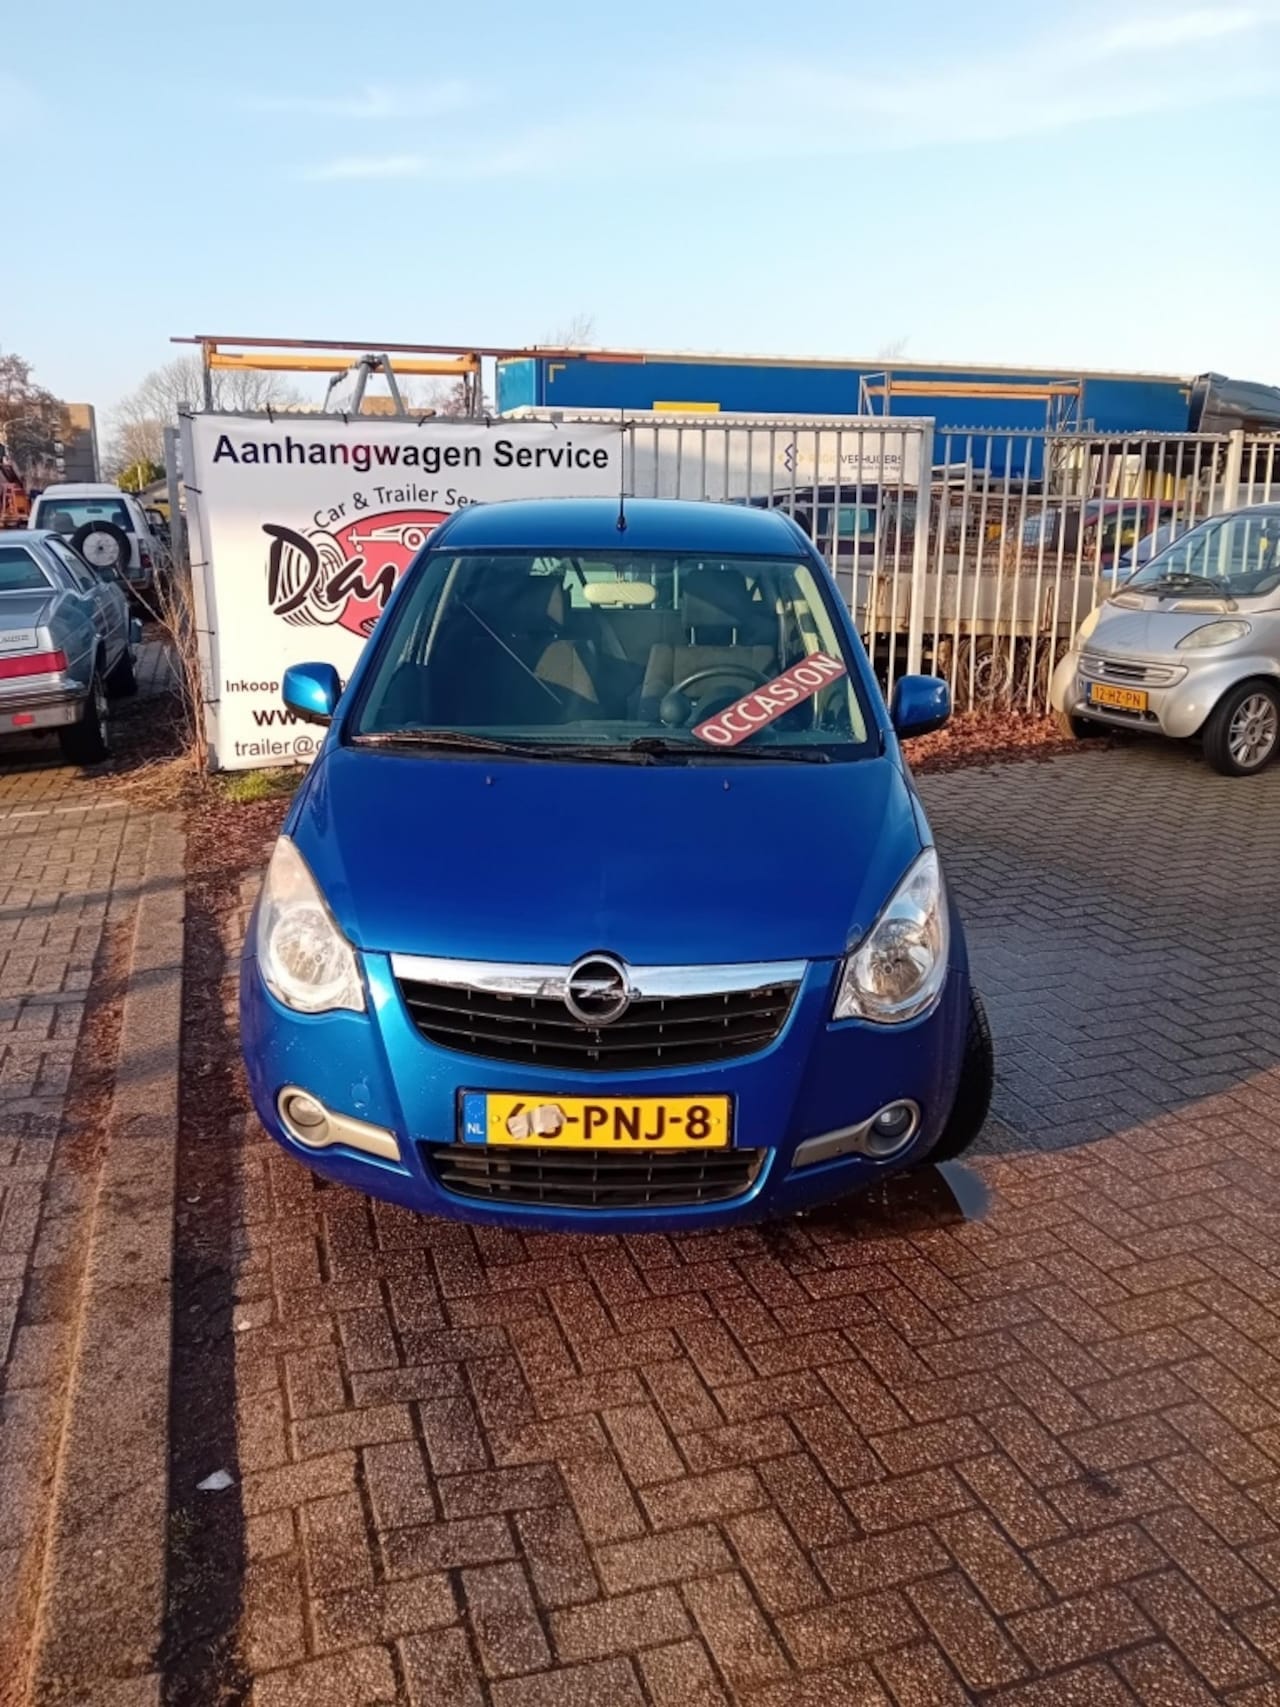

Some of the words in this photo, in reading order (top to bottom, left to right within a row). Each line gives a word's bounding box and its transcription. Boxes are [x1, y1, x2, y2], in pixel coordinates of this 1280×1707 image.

[213, 434, 481, 474] Aanhangwagen
[493, 440, 609, 468] Service
[313, 502, 347, 529] Car
[352, 491, 370, 511] &
[373, 483, 439, 505] Trailer
[226, 679, 279, 693] Inkoop
[702, 654, 843, 744] OCCASION
[1095, 686, 1141, 707] 12-HZ-PN
[467, 1123, 484, 1135] NL
